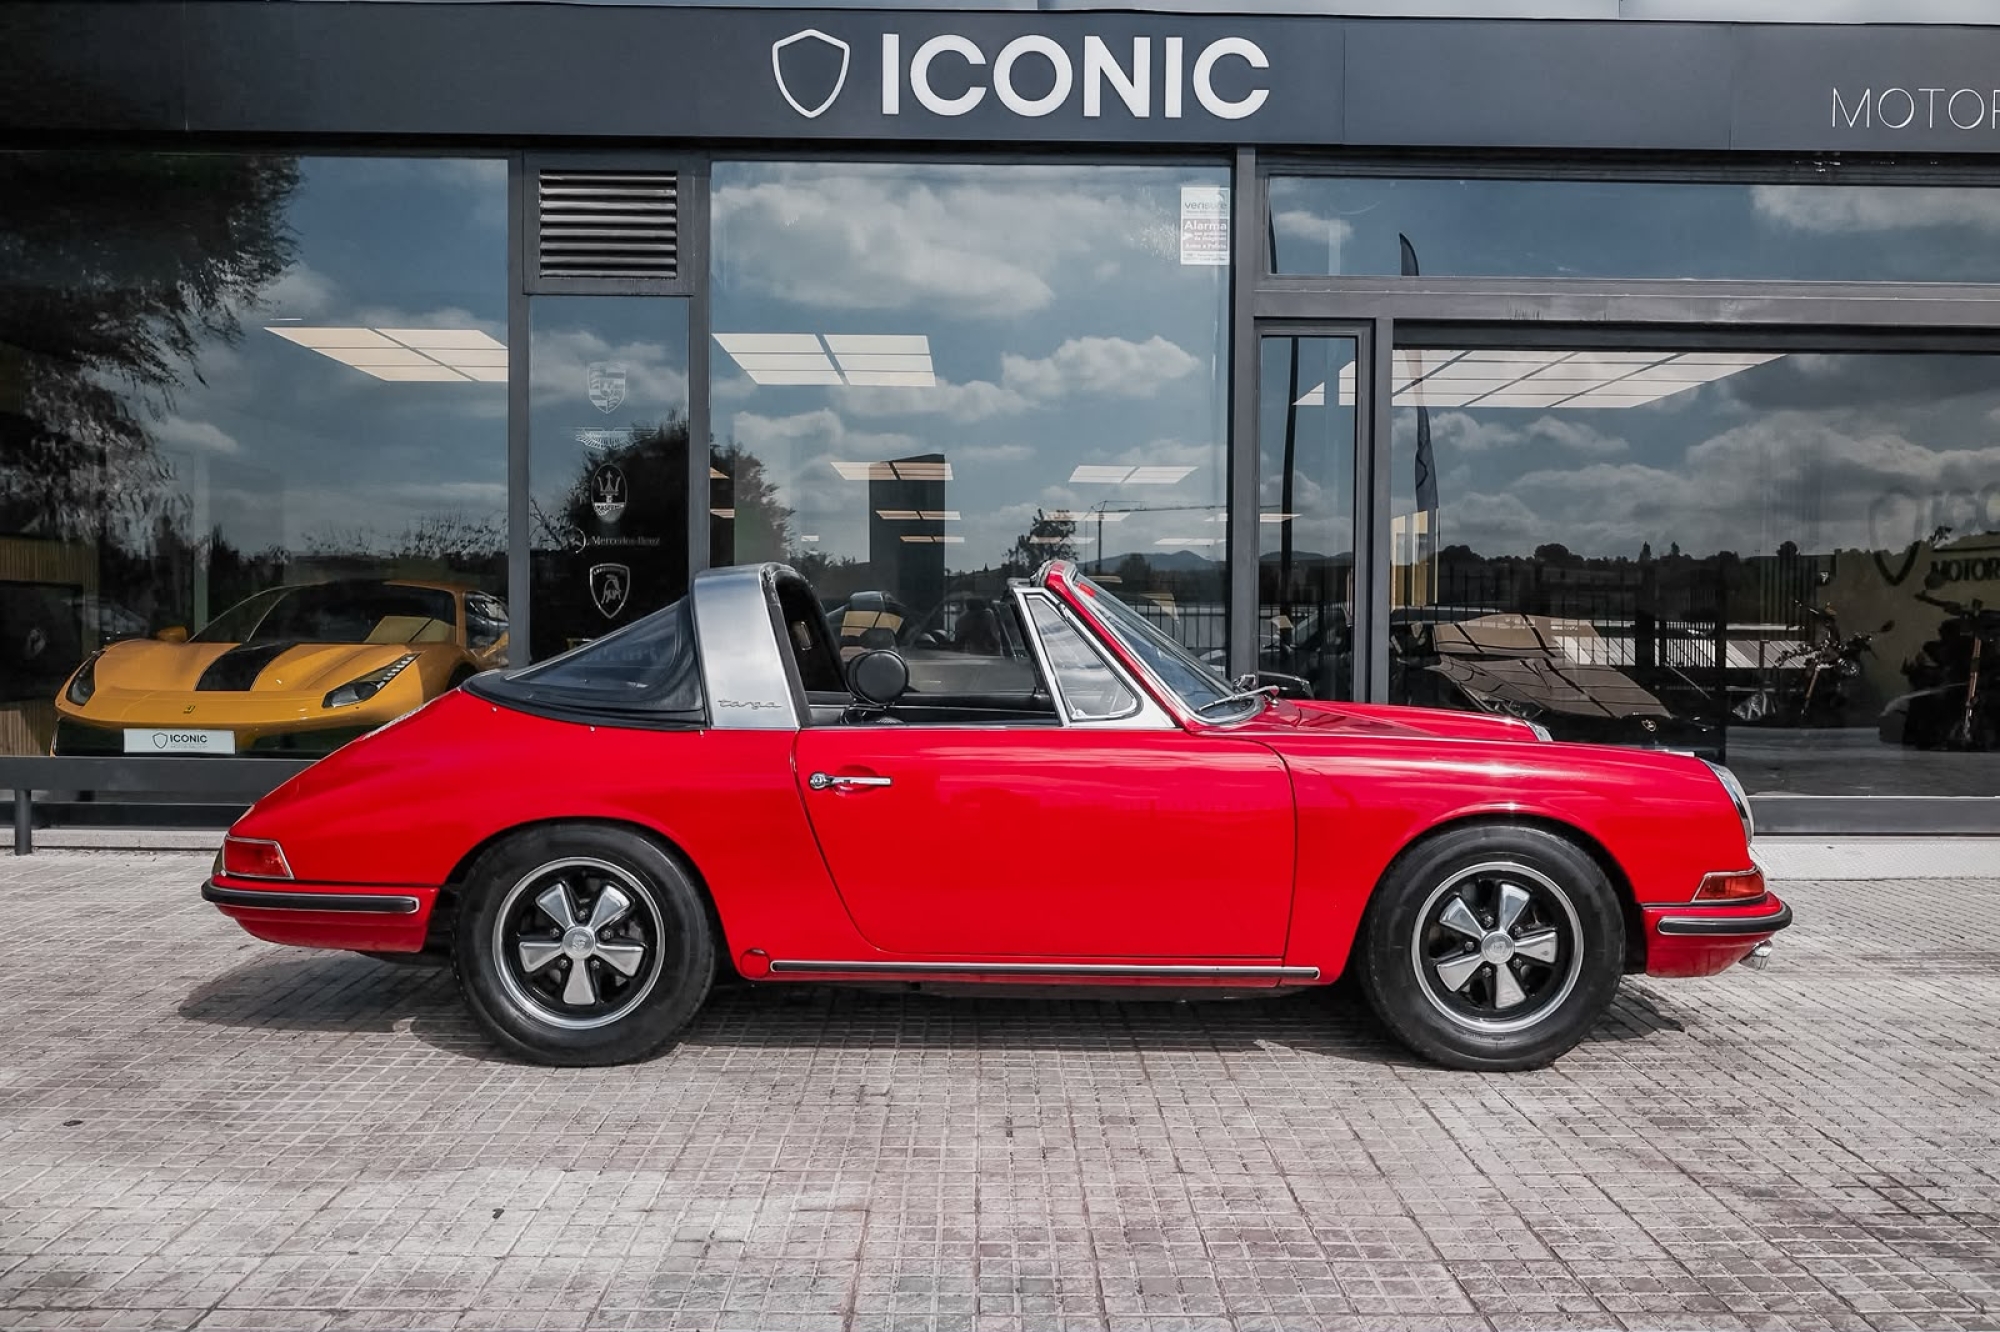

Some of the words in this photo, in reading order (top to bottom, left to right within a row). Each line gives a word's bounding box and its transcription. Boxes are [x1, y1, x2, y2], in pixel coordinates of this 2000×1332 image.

[883, 33, 1270, 119] ICONIC
[1184, 220, 1227, 231] Alarma
[717, 700, 782, 710] targa
[169, 734, 208, 743] ICONIC
